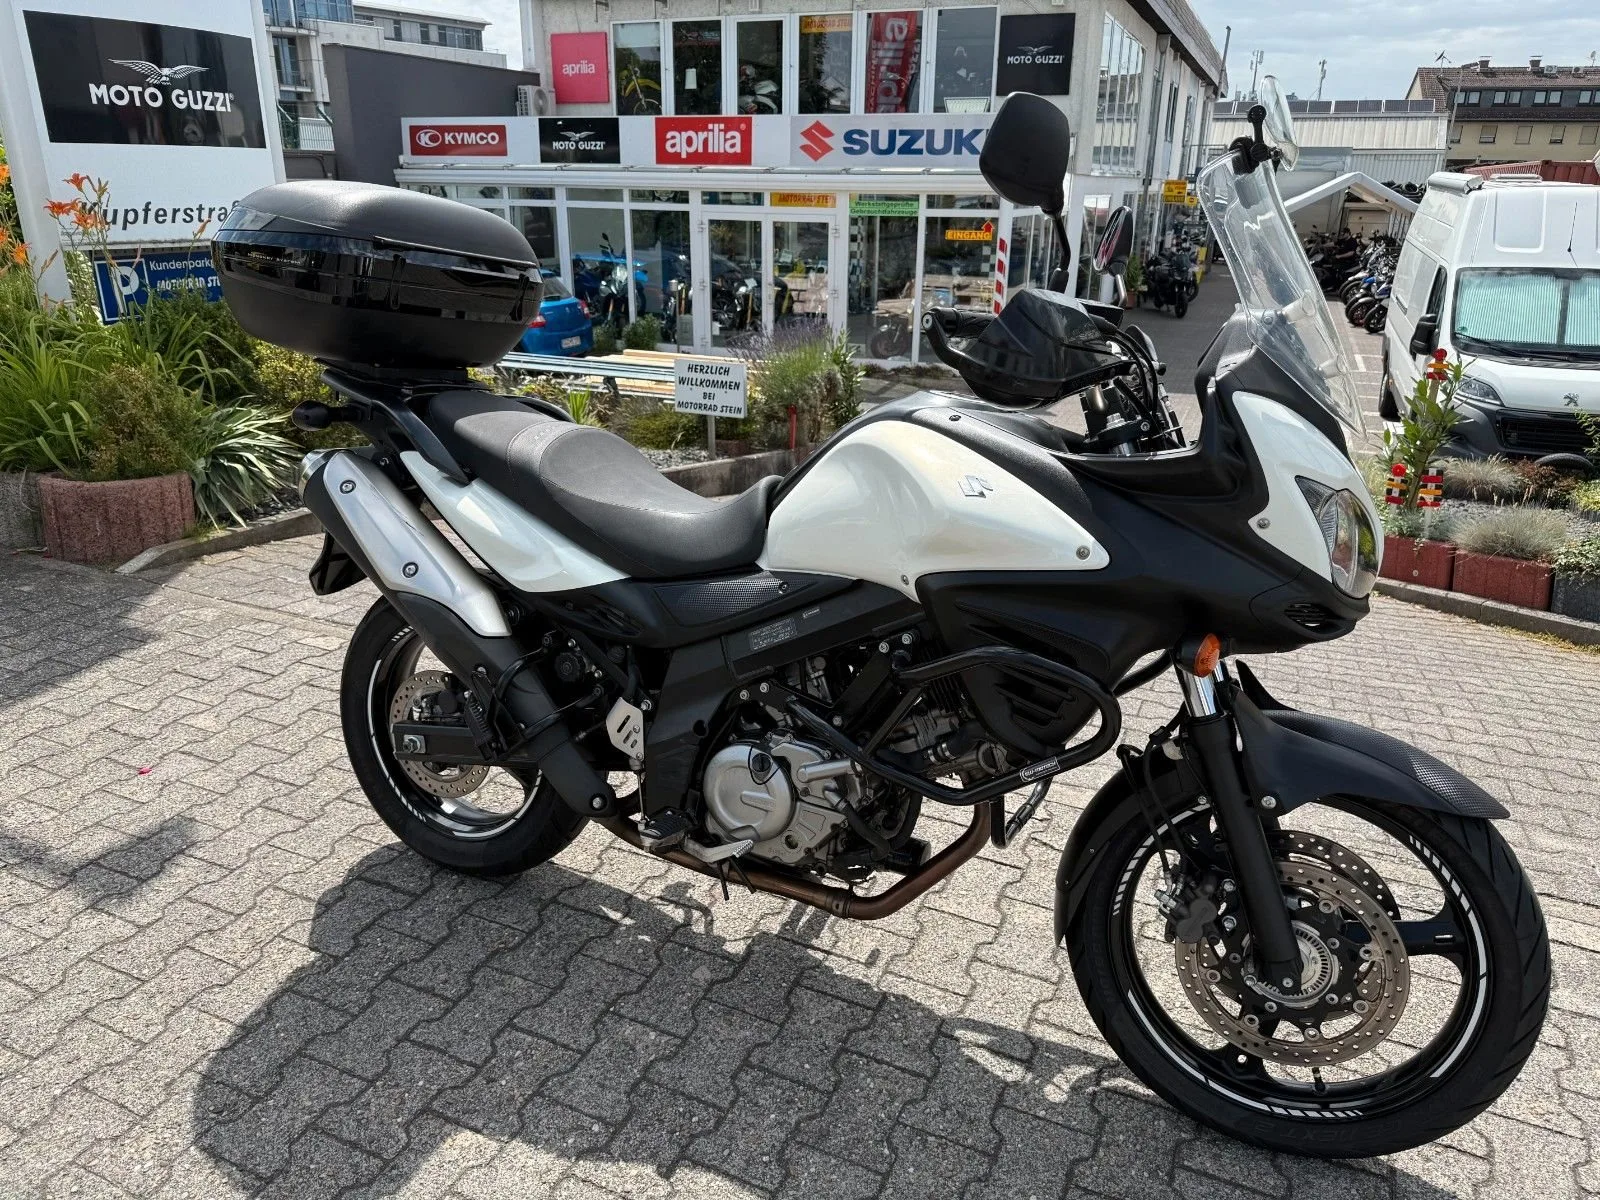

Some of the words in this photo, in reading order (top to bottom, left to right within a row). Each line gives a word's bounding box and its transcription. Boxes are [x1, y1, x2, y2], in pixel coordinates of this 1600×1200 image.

[1007, 55, 1032, 64] MOTO
[1034, 54, 1063, 64] GUZZI
[562, 60, 595, 76] aprilia
[88, 83, 163, 108] MOTO
[171, 88, 232, 113] GUZZI
[444, 132, 499, 145] KYMCO
[552, 140, 575, 150] MOTO
[578, 140, 604, 150] GUZZI
[665, 123, 741, 158] aprilia
[842, 128, 988, 155] SUZUK
[947, 231, 991, 240] EINGANG
[110, 265, 140, 314] P
[687, 363, 730, 376] HERZLICH
[678, 376, 741, 391] WILLKOMMEN
[702, 392, 716, 401] BEI
[677, 401, 718, 412] MOTORRAD
[720, 405, 742, 415] STEIN
